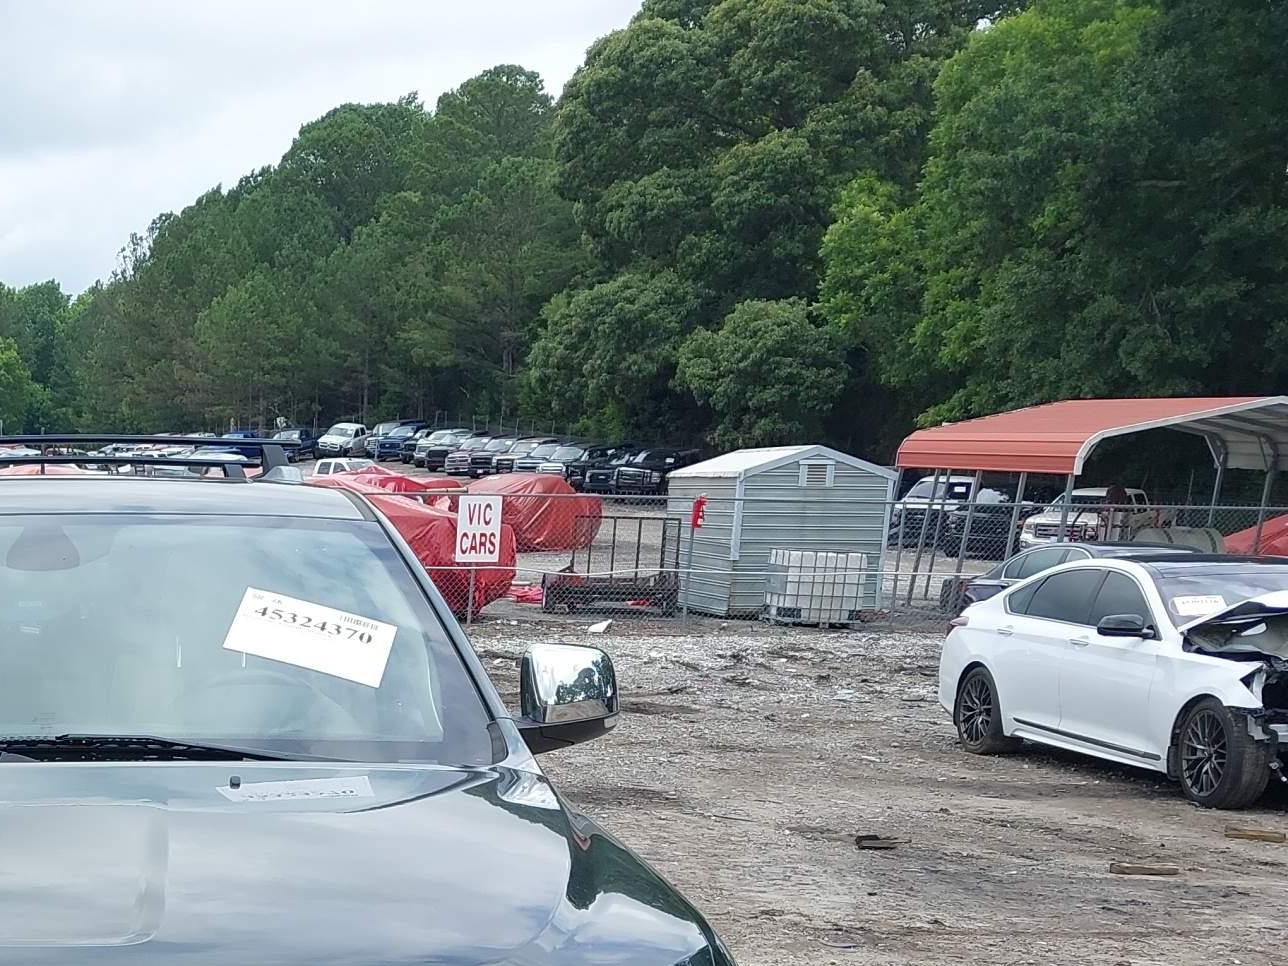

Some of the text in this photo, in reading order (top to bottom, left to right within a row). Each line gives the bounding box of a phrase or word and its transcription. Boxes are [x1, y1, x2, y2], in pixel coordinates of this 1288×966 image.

[467, 502, 493, 526] VIC
[459, 531, 497, 555] CARS
[254, 605, 373, 645] 45324370
